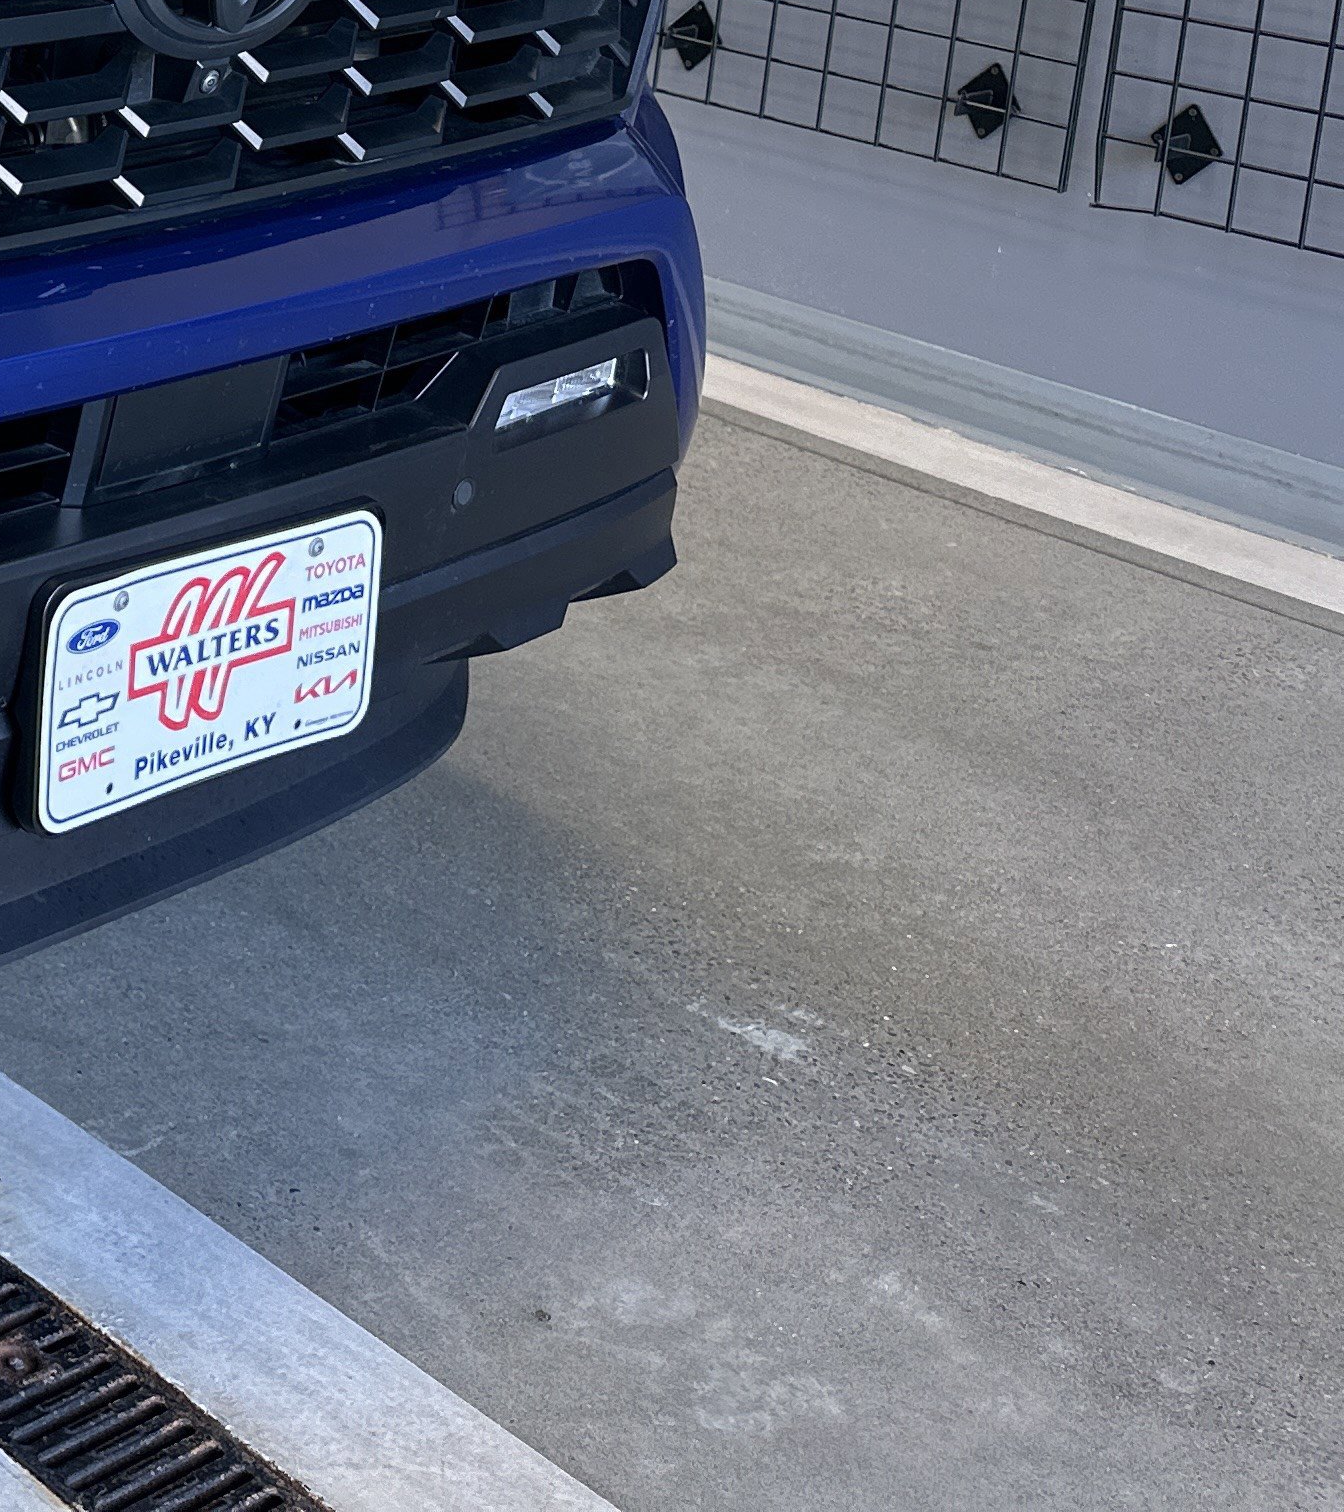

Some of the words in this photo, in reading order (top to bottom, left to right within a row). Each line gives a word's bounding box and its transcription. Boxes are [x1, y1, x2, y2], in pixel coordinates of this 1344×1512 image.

[305, 553, 366, 581] TOYOTA
[76, 625, 111, 650] Ford
[298, 614, 363, 641] MITSUBISHI
[146, 618, 280, 677] WALTERS
[296, 640, 361, 669] NISSAN
[58, 660, 124, 691] LINCOLN
[55, 722, 120, 752] CHEVROLET
[134, 731, 234, 781] Pikeville,
[244, 711, 277, 742] KY
[58, 745, 116, 782] GMC
